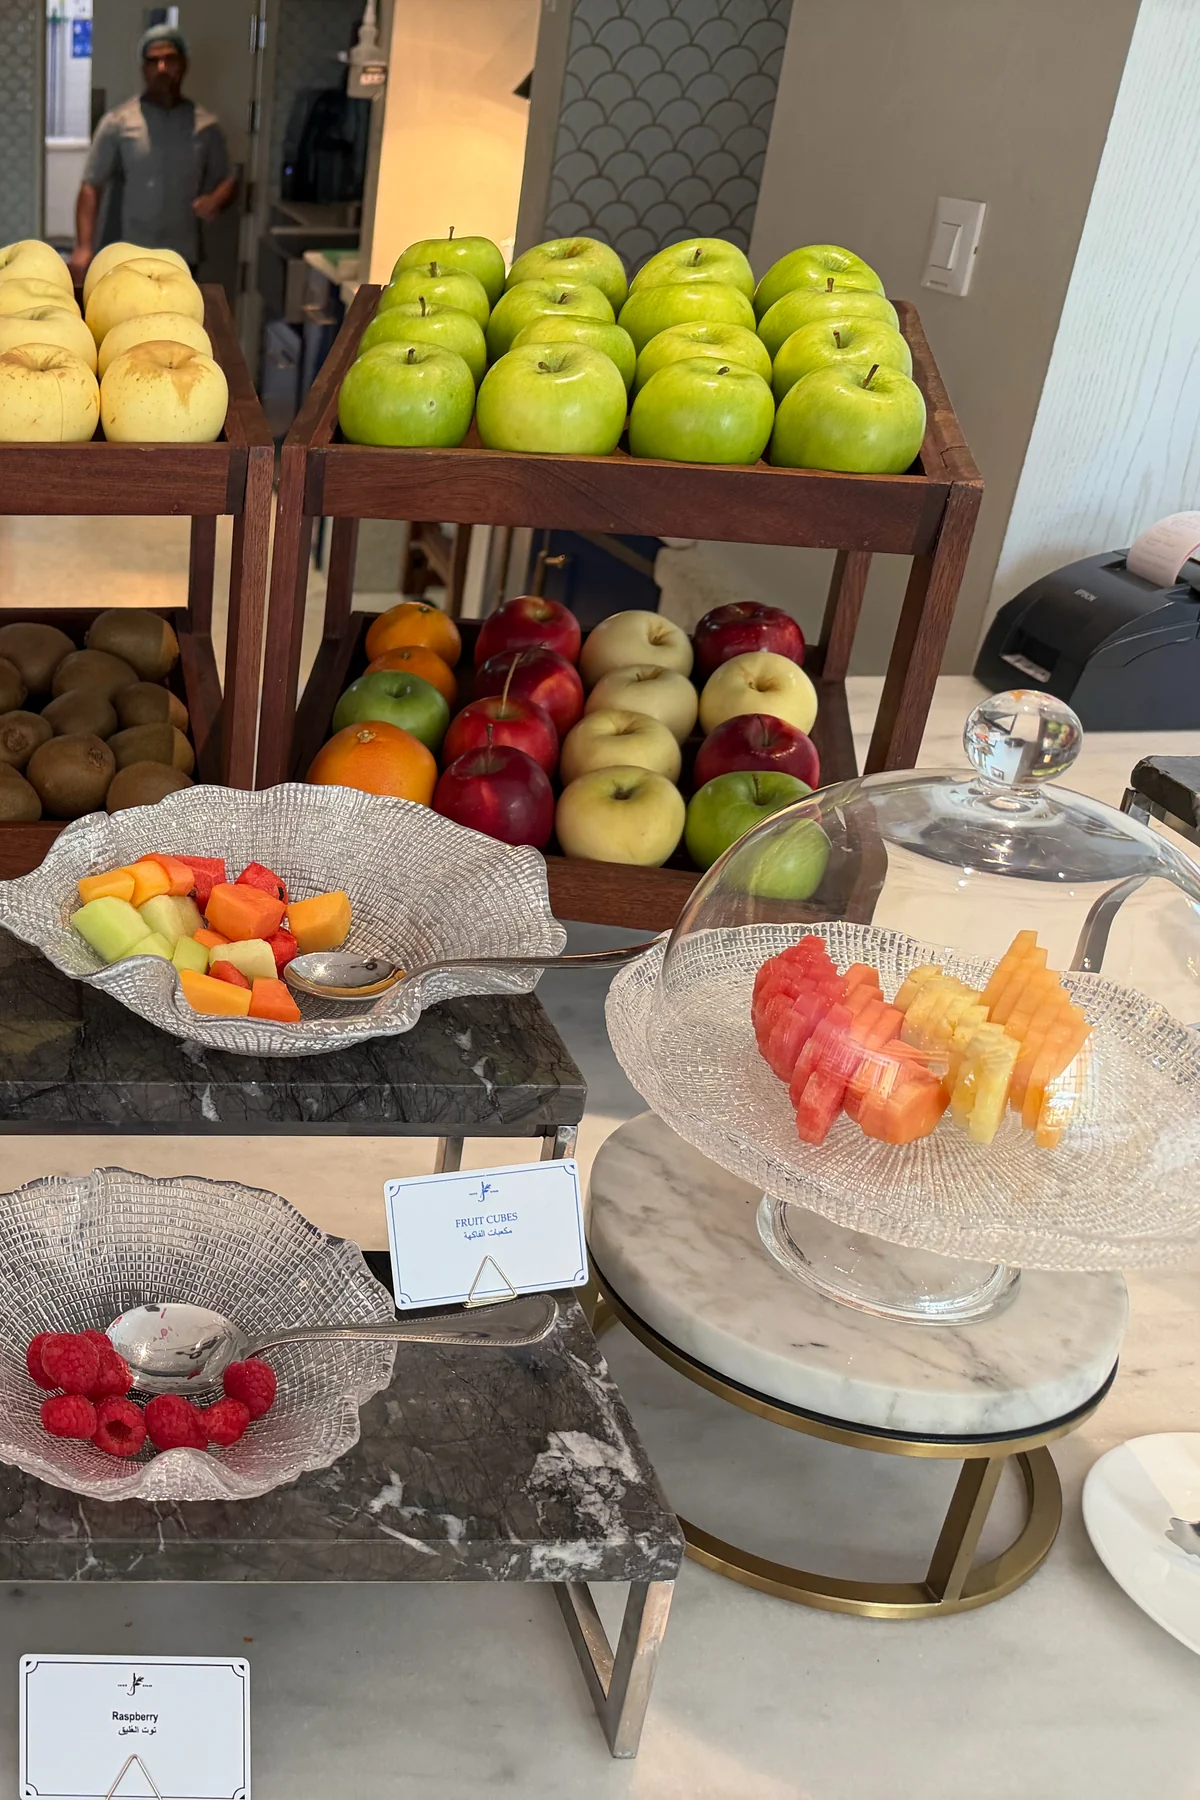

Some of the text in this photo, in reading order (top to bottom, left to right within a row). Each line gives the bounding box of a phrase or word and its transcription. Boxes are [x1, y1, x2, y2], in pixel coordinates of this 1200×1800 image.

[455, 1212, 518, 1228] FRUIT CUBES
[487, 1226, 513, 1237] مكعبات
[112, 1710, 159, 1724] Raspberry
[141, 1726, 157, 1736] توت
